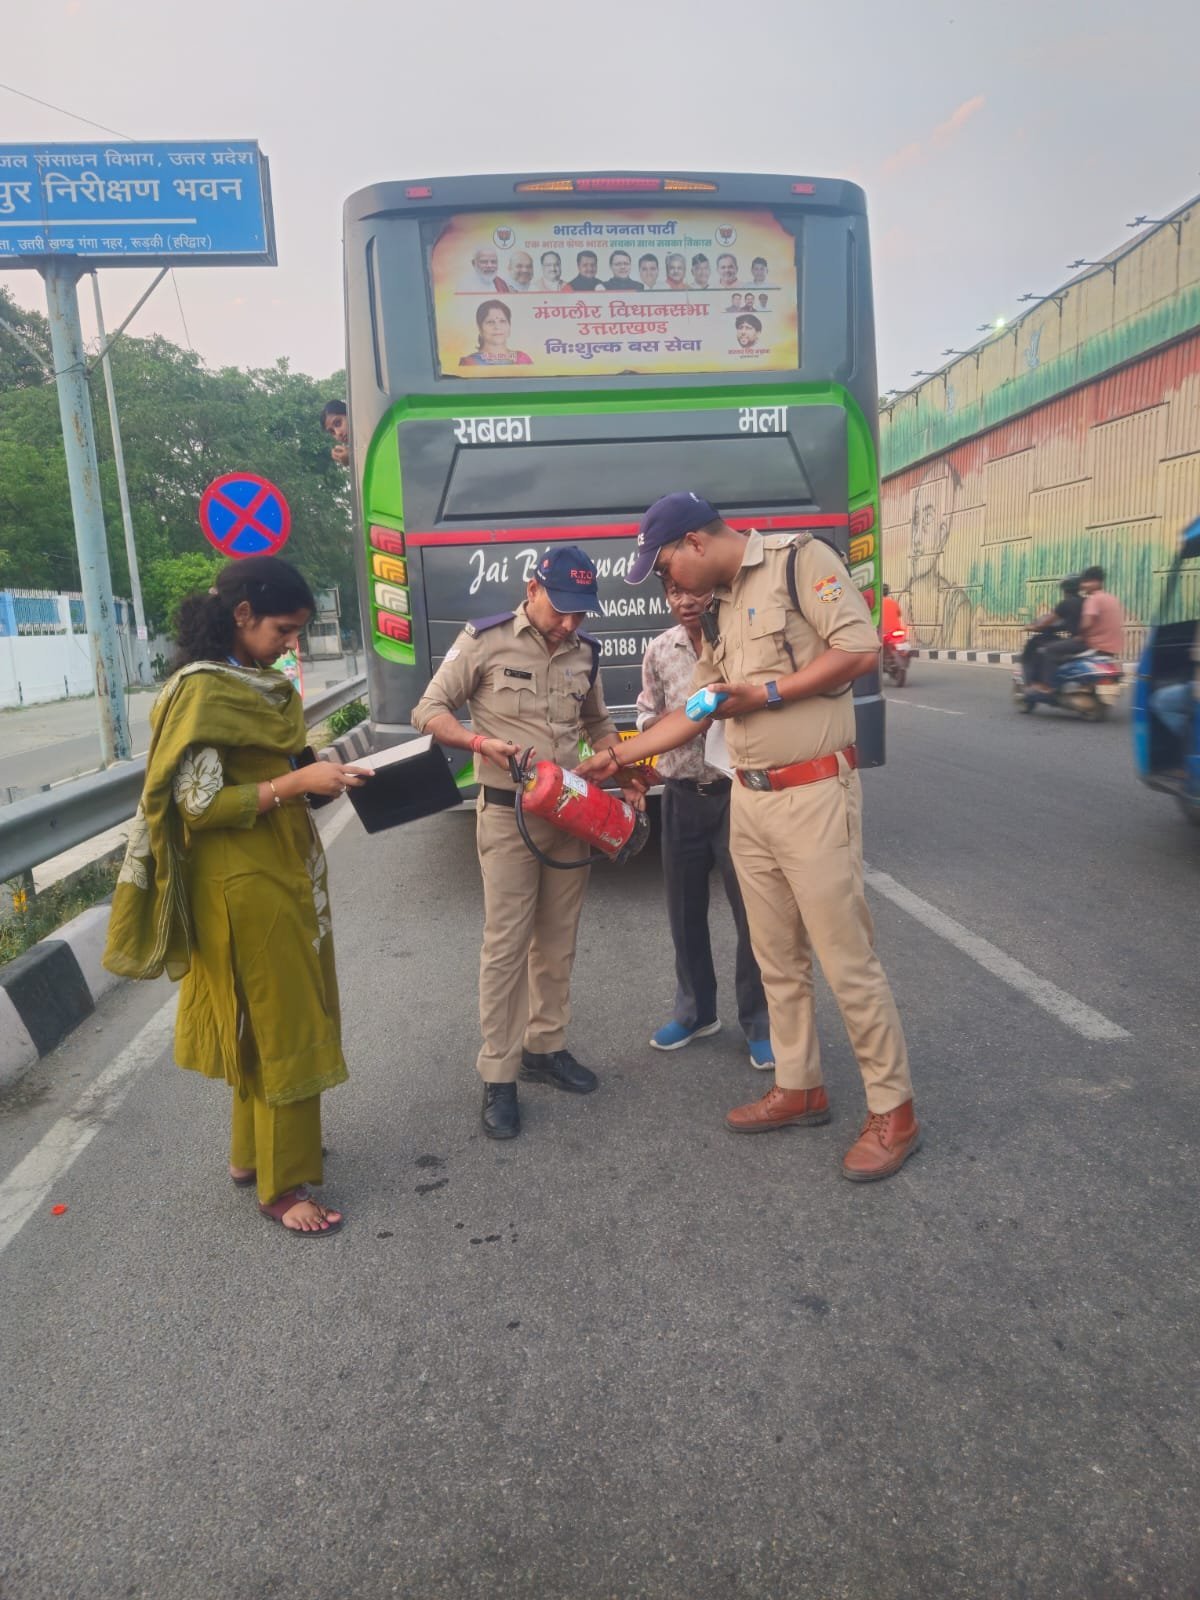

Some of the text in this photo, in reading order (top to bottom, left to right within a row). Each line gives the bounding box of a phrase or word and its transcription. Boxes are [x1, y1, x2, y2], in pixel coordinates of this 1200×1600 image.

[33, 150, 97, 168] संसाधन
[104, 149, 162, 167] विभाग,
[168, 152, 206, 166] उत्तर
[211, 147, 254, 165] प्रदेश
[41, 171, 160, 203] निरीक्षण
[172, 178, 242, 201] भवन
[553, 220, 678, 236] भारतीय जनता पार्टी
[533, 300, 710, 319] मंगलौर विधानसभा
[577, 321, 669, 336] उत्तराखण्ड
[628, 340, 660, 353] बस
[664, 336, 702, 352] सेवा
[452, 406, 788, 444] सबका भला
[469, 549, 509, 595] Jai
[586, 597, 646, 618] NAGAR
